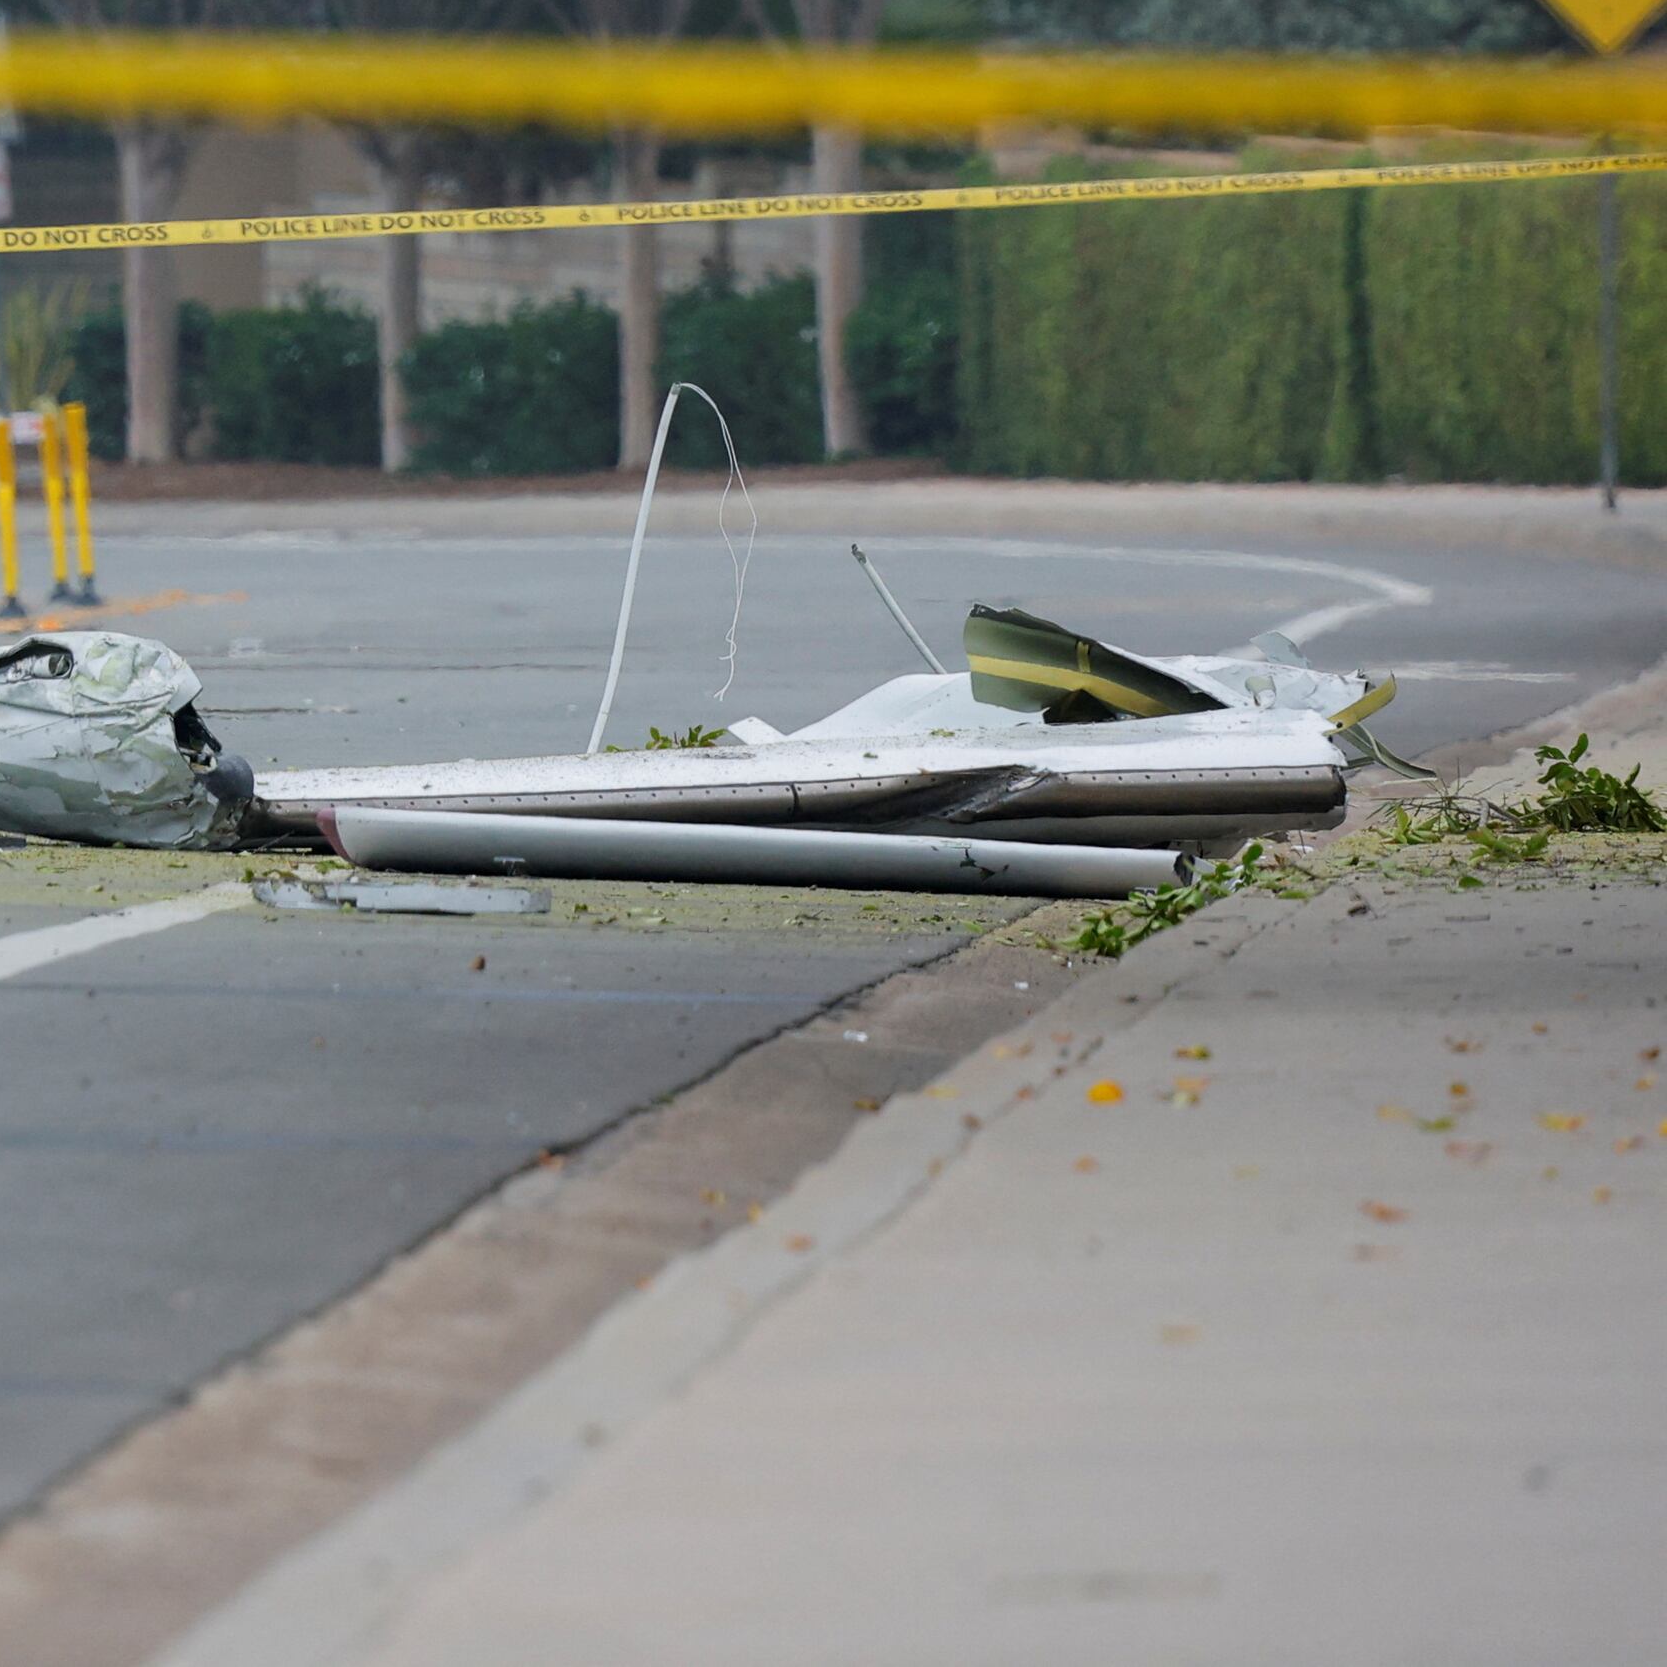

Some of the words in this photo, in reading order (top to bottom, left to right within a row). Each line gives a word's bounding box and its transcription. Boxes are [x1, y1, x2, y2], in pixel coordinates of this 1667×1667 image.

[994, 186, 1071, 201] POLICE
[617, 204, 696, 221] POLICE
[698, 202, 747, 217] LINE
[754, 200, 789, 215] DO
[794, 198, 843, 213] NOT
[851, 193, 923, 210] CROSS
[3, 230, 37, 247] DO
[43, 228, 90, 245] NOT
[95, 224, 169, 243] CROSS
[239, 218, 318, 238] POLICE
[322, 217, 372, 234] LINE
[378, 215, 415, 231] DO
[419, 213, 468, 229] NOT
[471, 209, 546, 227] CROSS
